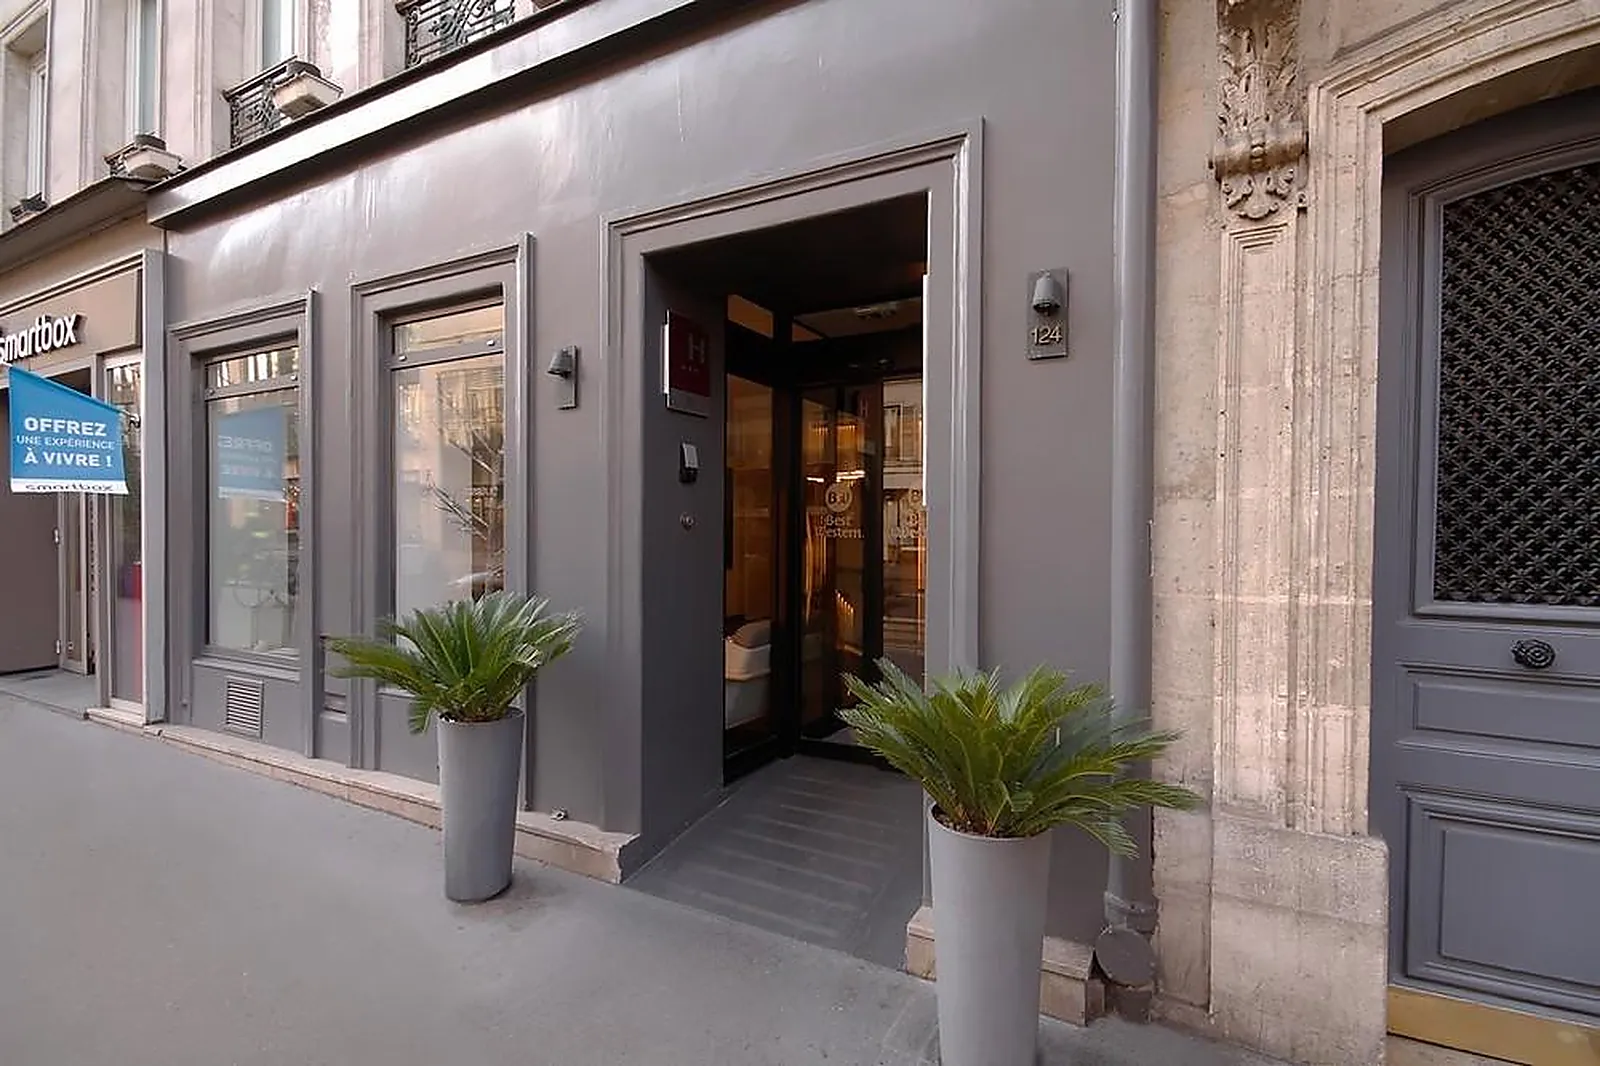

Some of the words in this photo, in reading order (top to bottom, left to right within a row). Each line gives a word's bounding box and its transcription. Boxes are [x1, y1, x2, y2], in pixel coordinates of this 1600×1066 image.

[1031, 325, 1063, 345] 124
[688, 332, 705, 364] H
[24, 416, 107, 437] OFFREZ
[16, 435, 41, 446] UNE
[24, 447, 38, 464] À
[43, 451, 101, 467] VIVRE
[106, 455, 112, 467] !
[25, 482, 113, 491] smartbox
